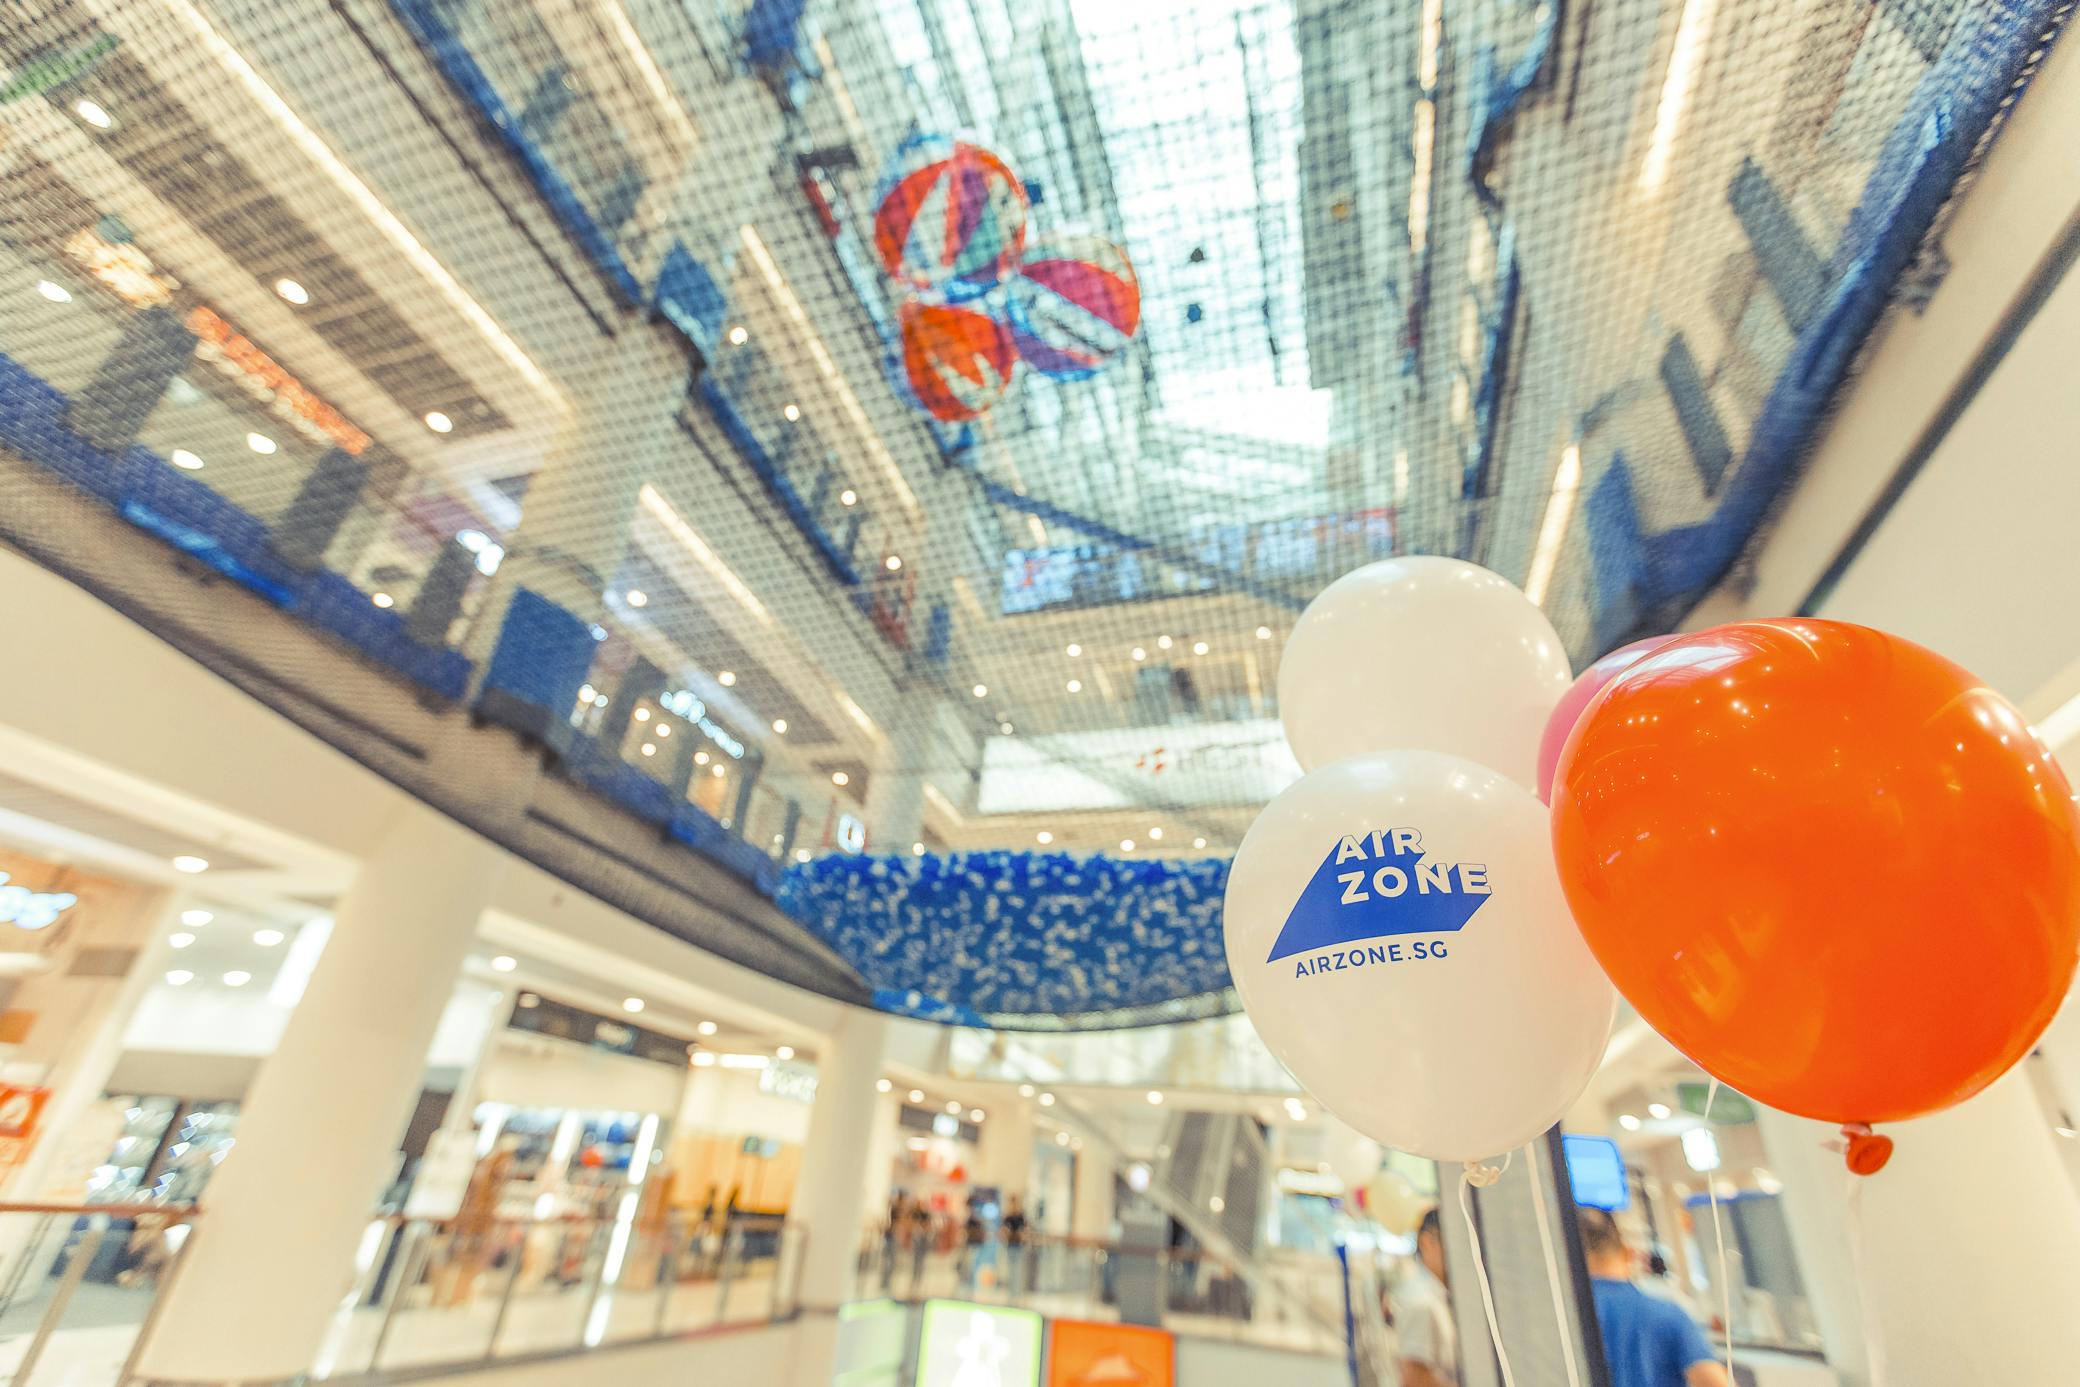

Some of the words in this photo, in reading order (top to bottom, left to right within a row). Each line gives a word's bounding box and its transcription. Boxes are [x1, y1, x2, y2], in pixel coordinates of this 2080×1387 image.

[1335, 826, 1426, 865] AIR
[1337, 862, 1493, 905] ZONE
[1295, 940, 1449, 979] AIRZONE.SG
